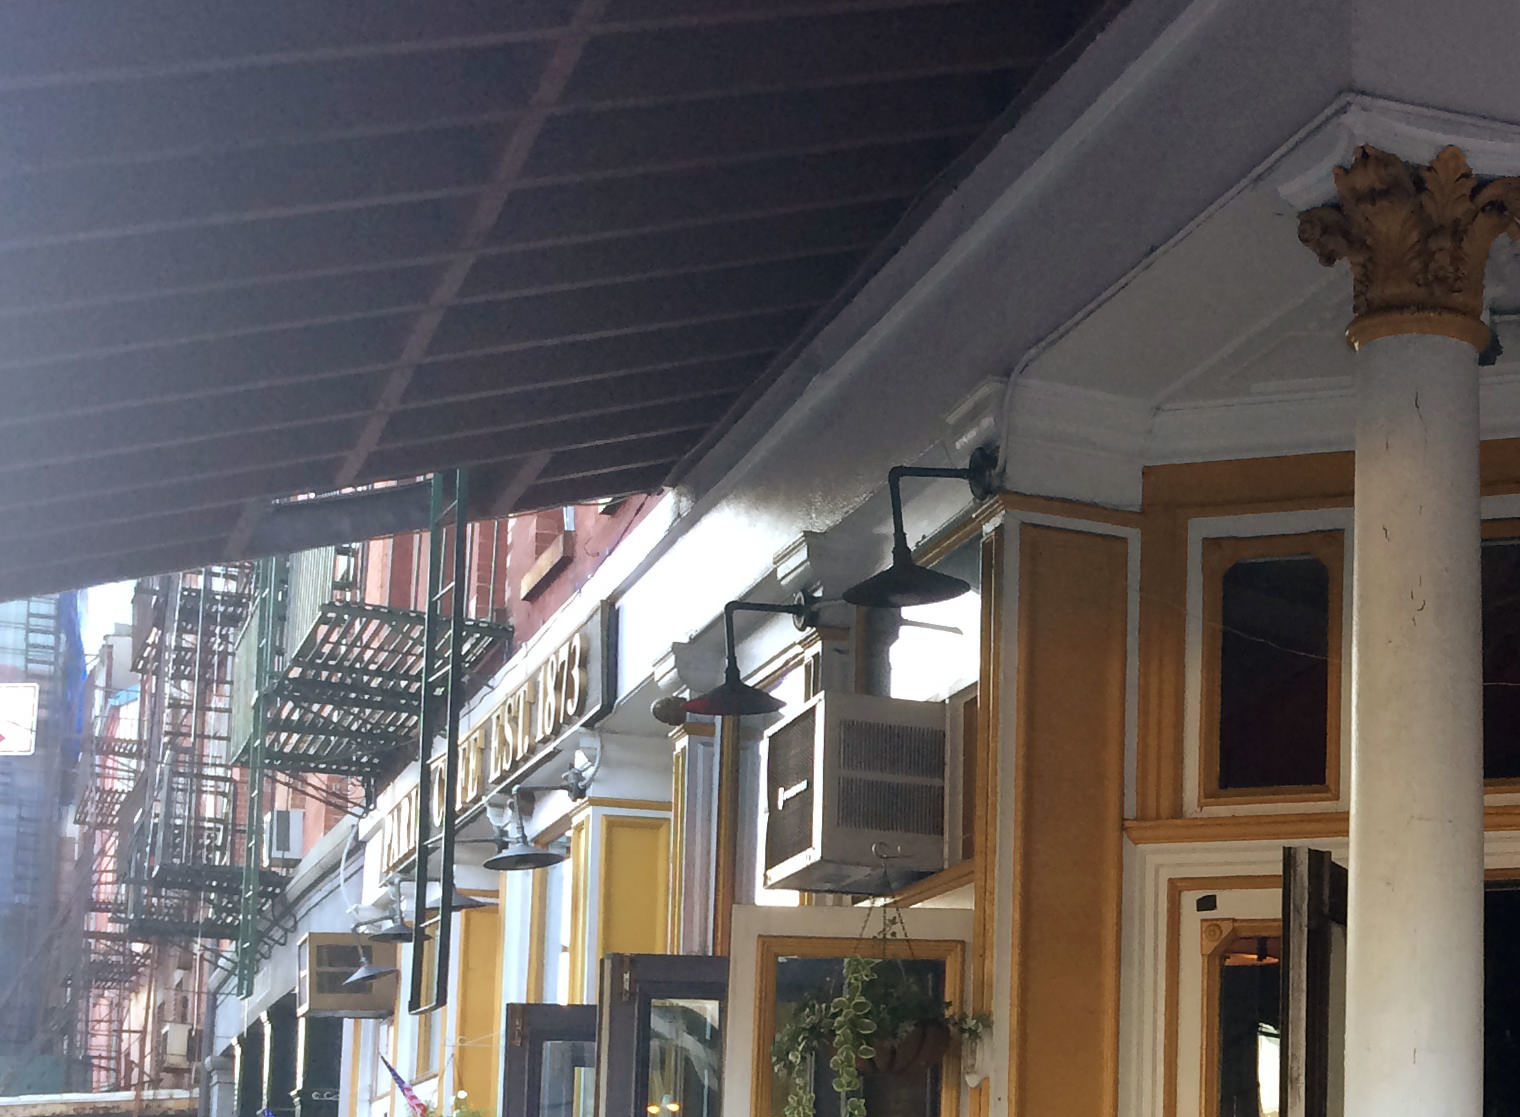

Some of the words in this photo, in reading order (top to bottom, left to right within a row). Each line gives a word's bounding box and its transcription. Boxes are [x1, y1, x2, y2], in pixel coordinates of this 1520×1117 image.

[382, 786, 420, 873] PARI
[431, 731, 485, 827] CFE
[488, 684, 533, 783] EST.
[535, 633, 588, 742] 1873
